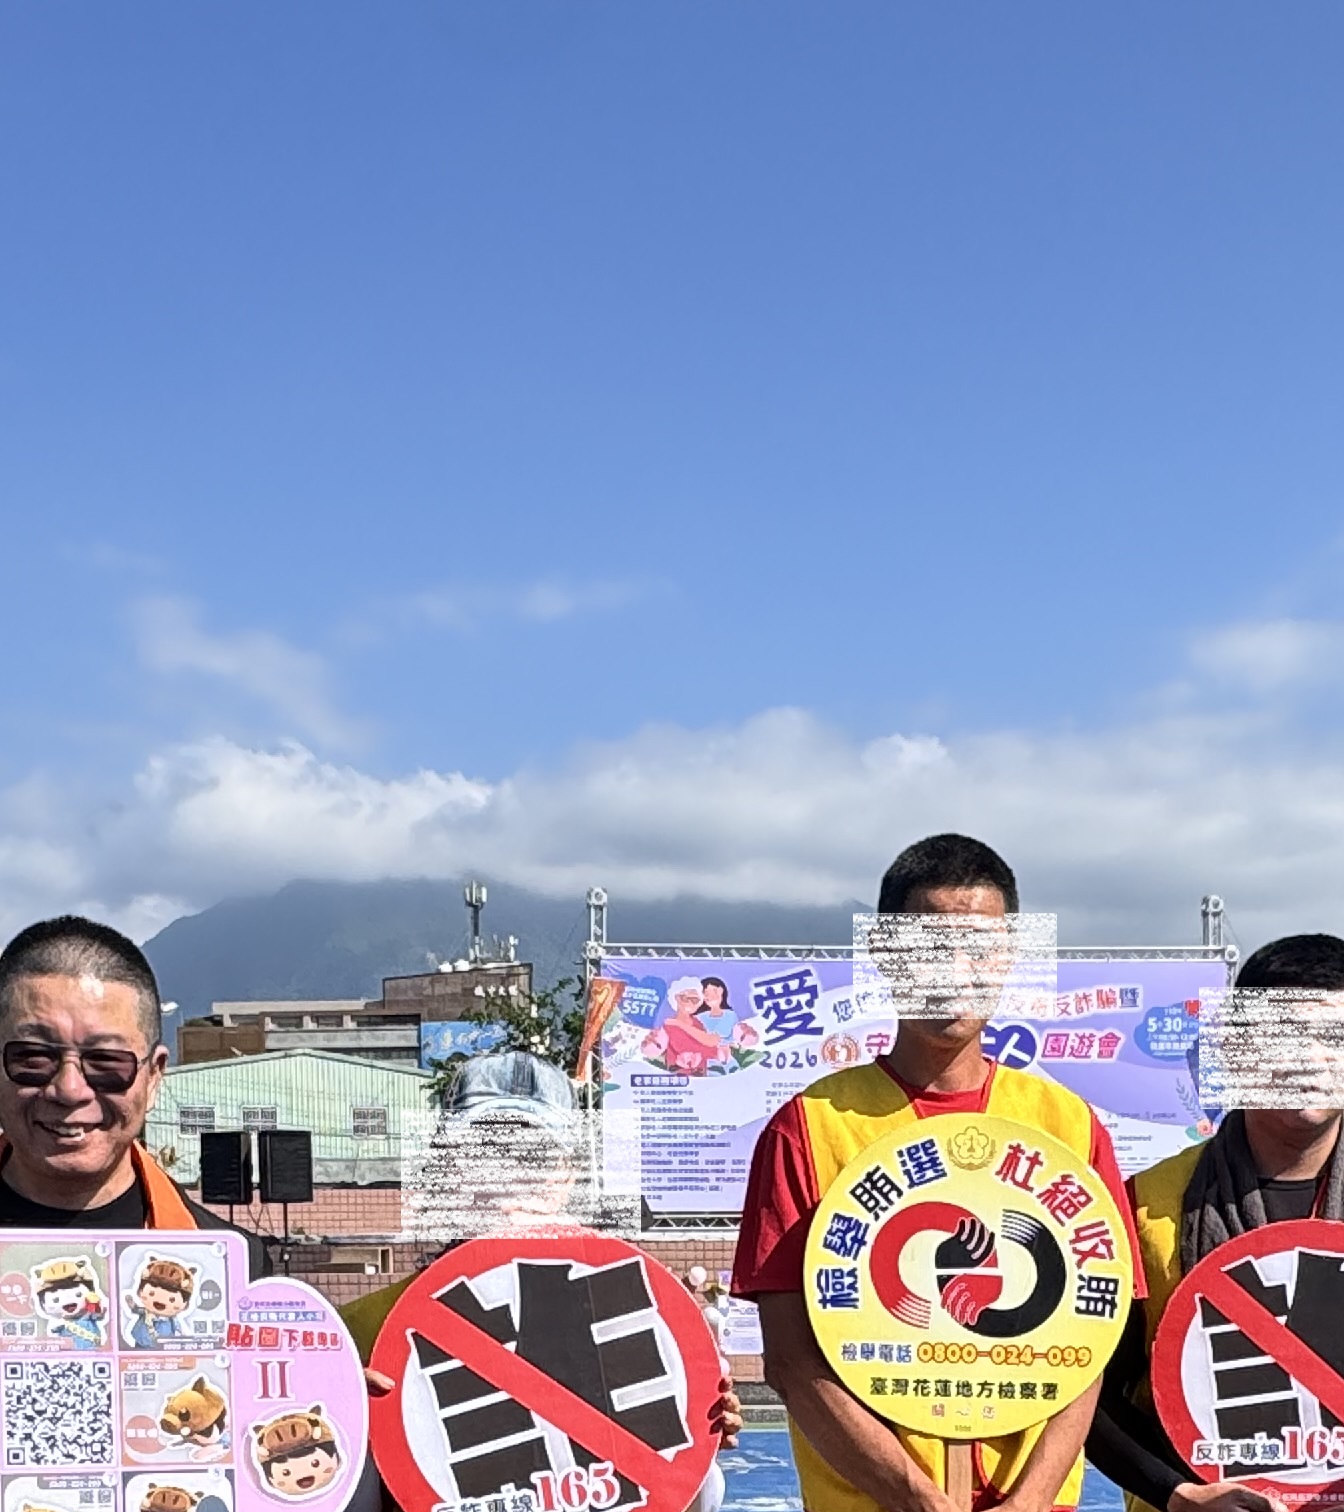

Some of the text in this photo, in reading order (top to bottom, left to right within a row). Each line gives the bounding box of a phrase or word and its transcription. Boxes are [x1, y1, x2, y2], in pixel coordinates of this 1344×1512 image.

[623, 1000, 657, 1017] 5577
[753, 968, 824, 1046] 愛
[759, 1050, 817, 1069] 2026
[1041, 1031, 1122, 1059] 園遊會
[816, 1138, 948, 1310] 檢舉賄選
[996, 1143, 1119, 1319] 杜絕收賄
[917, 1342, 1092, 1367] 0800-024-099
[870, 1377, 1059, 1400] 臺灣花蓮地方檢察署
